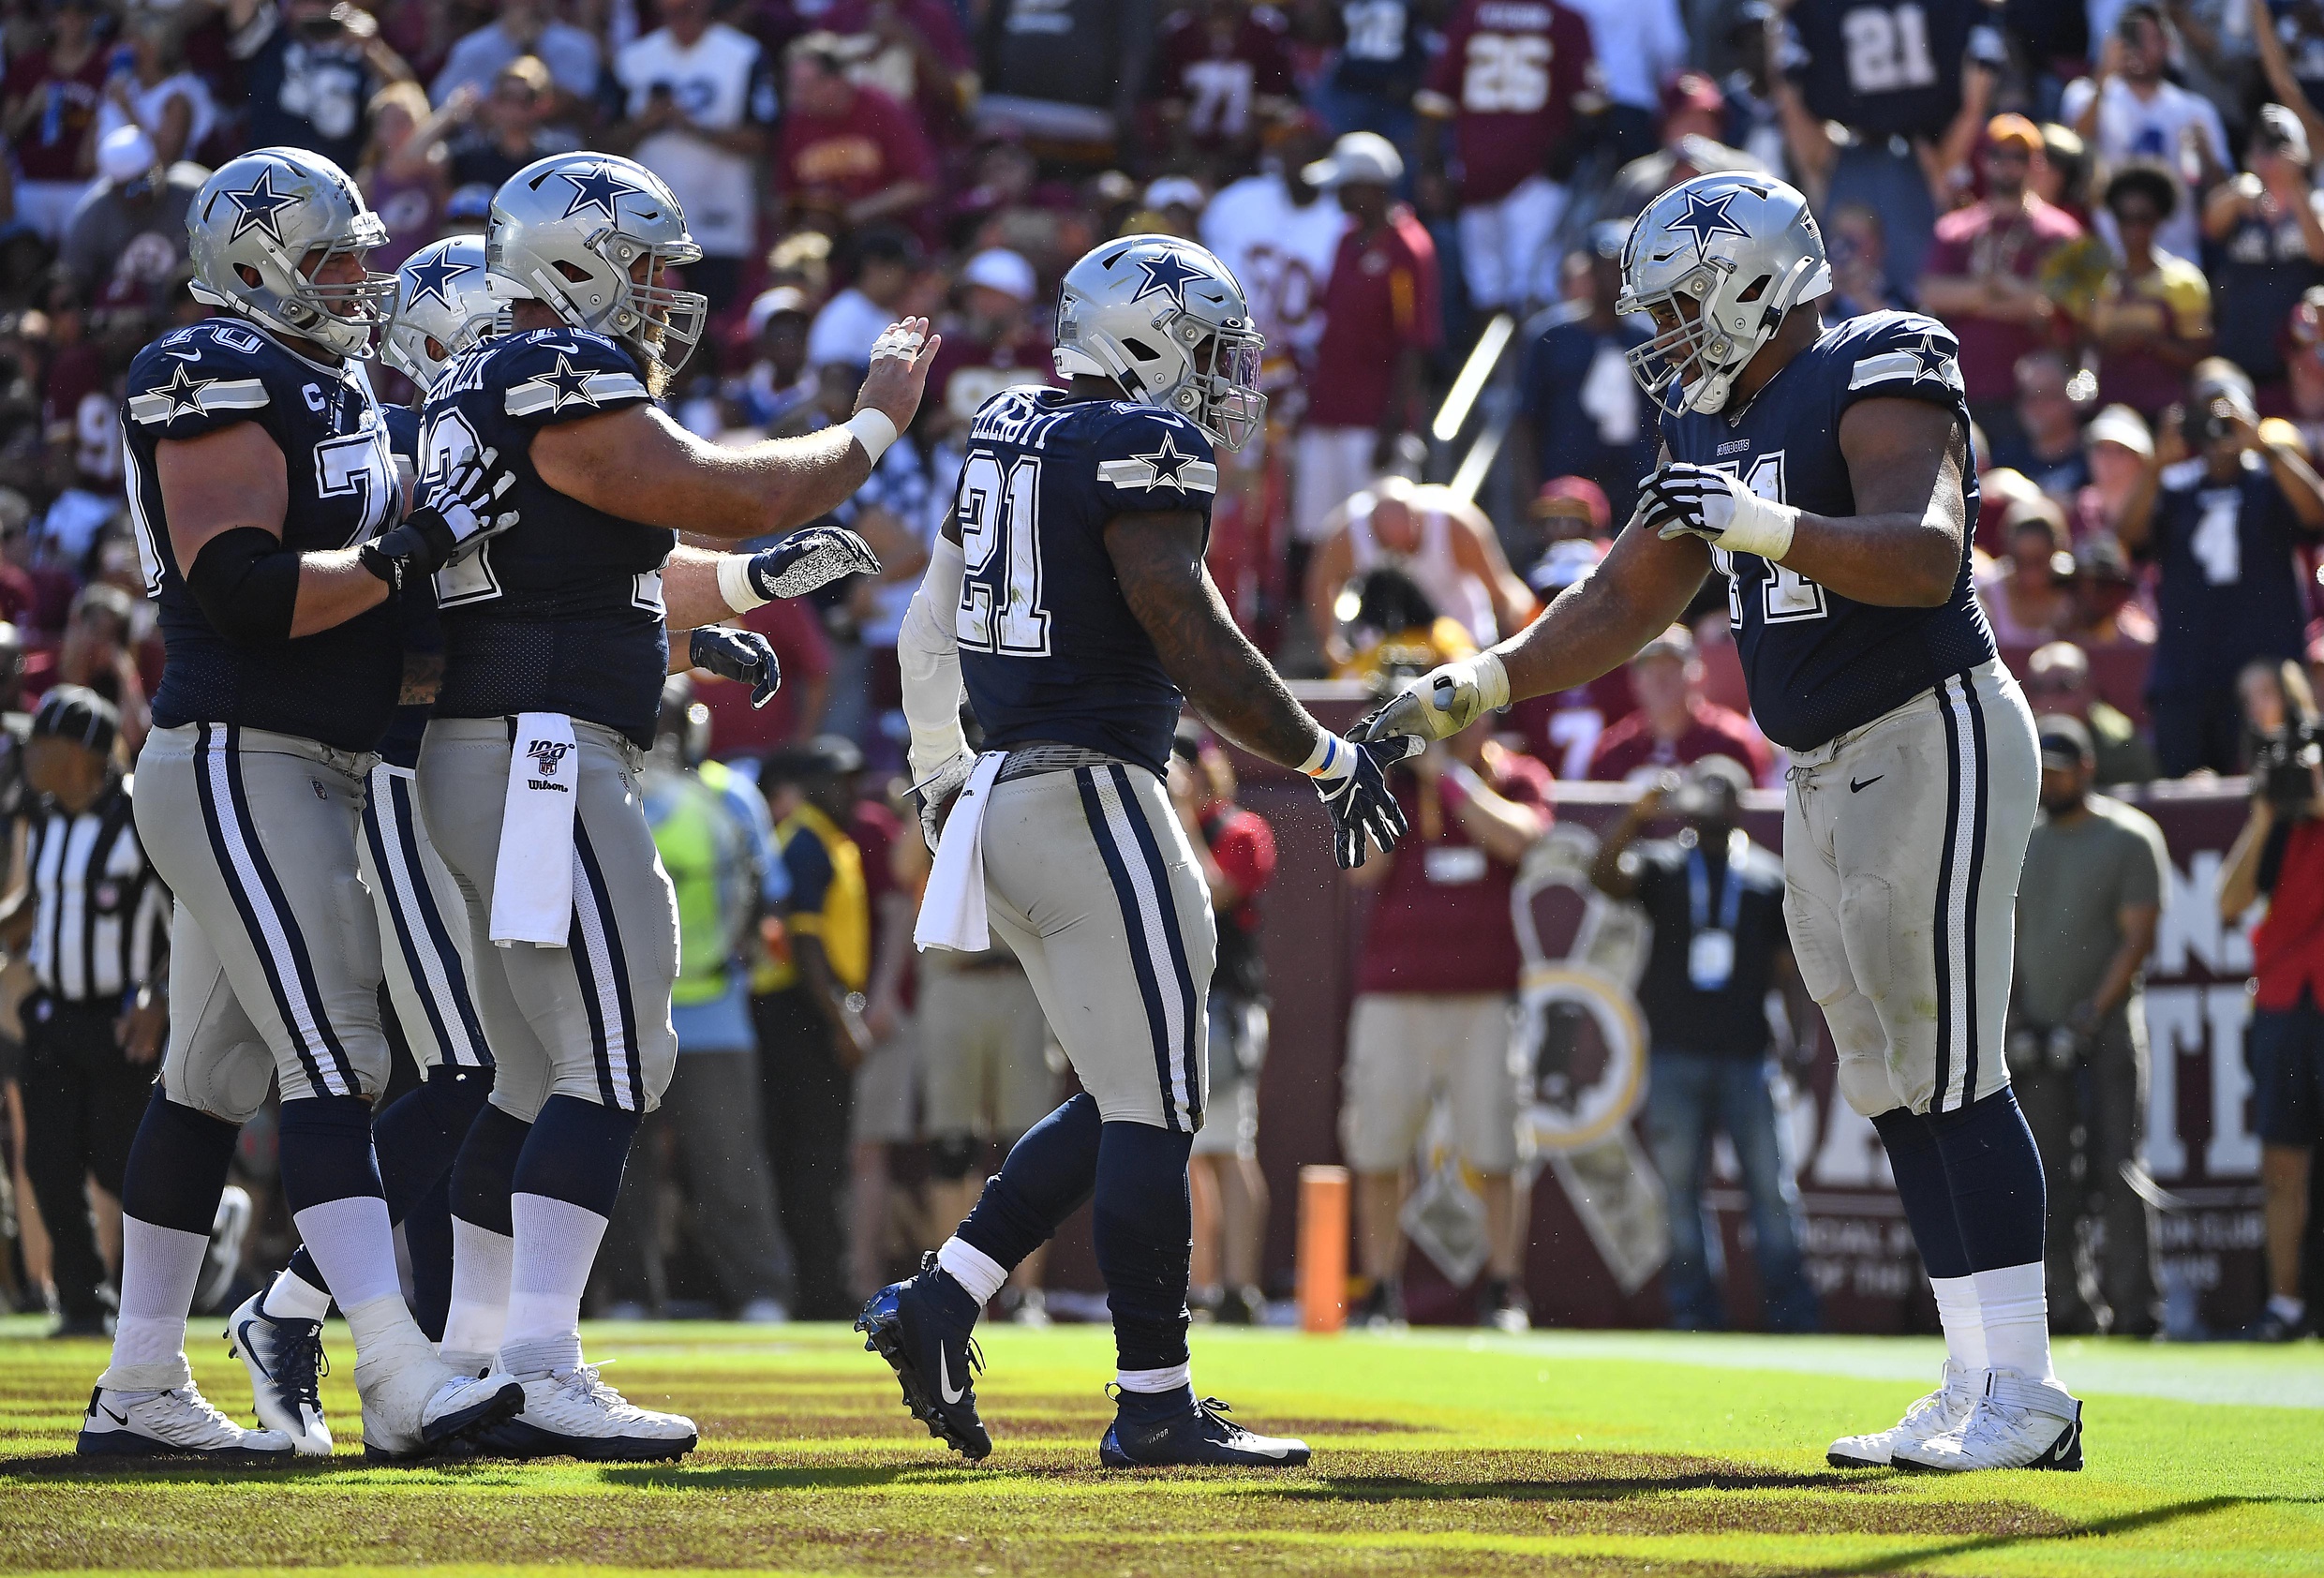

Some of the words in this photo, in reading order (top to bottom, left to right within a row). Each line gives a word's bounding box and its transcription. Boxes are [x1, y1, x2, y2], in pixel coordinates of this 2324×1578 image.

[1841, 5, 1936, 93] 21
[301, 382, 326, 412] C
[1578, 344, 1638, 445] 4
[955, 448, 1052, 657] 21
[540, 763, 555, 774] NFL
[527, 779, 565, 793] Wilson
[1147, 1427, 1169, 1445] VAPOR
